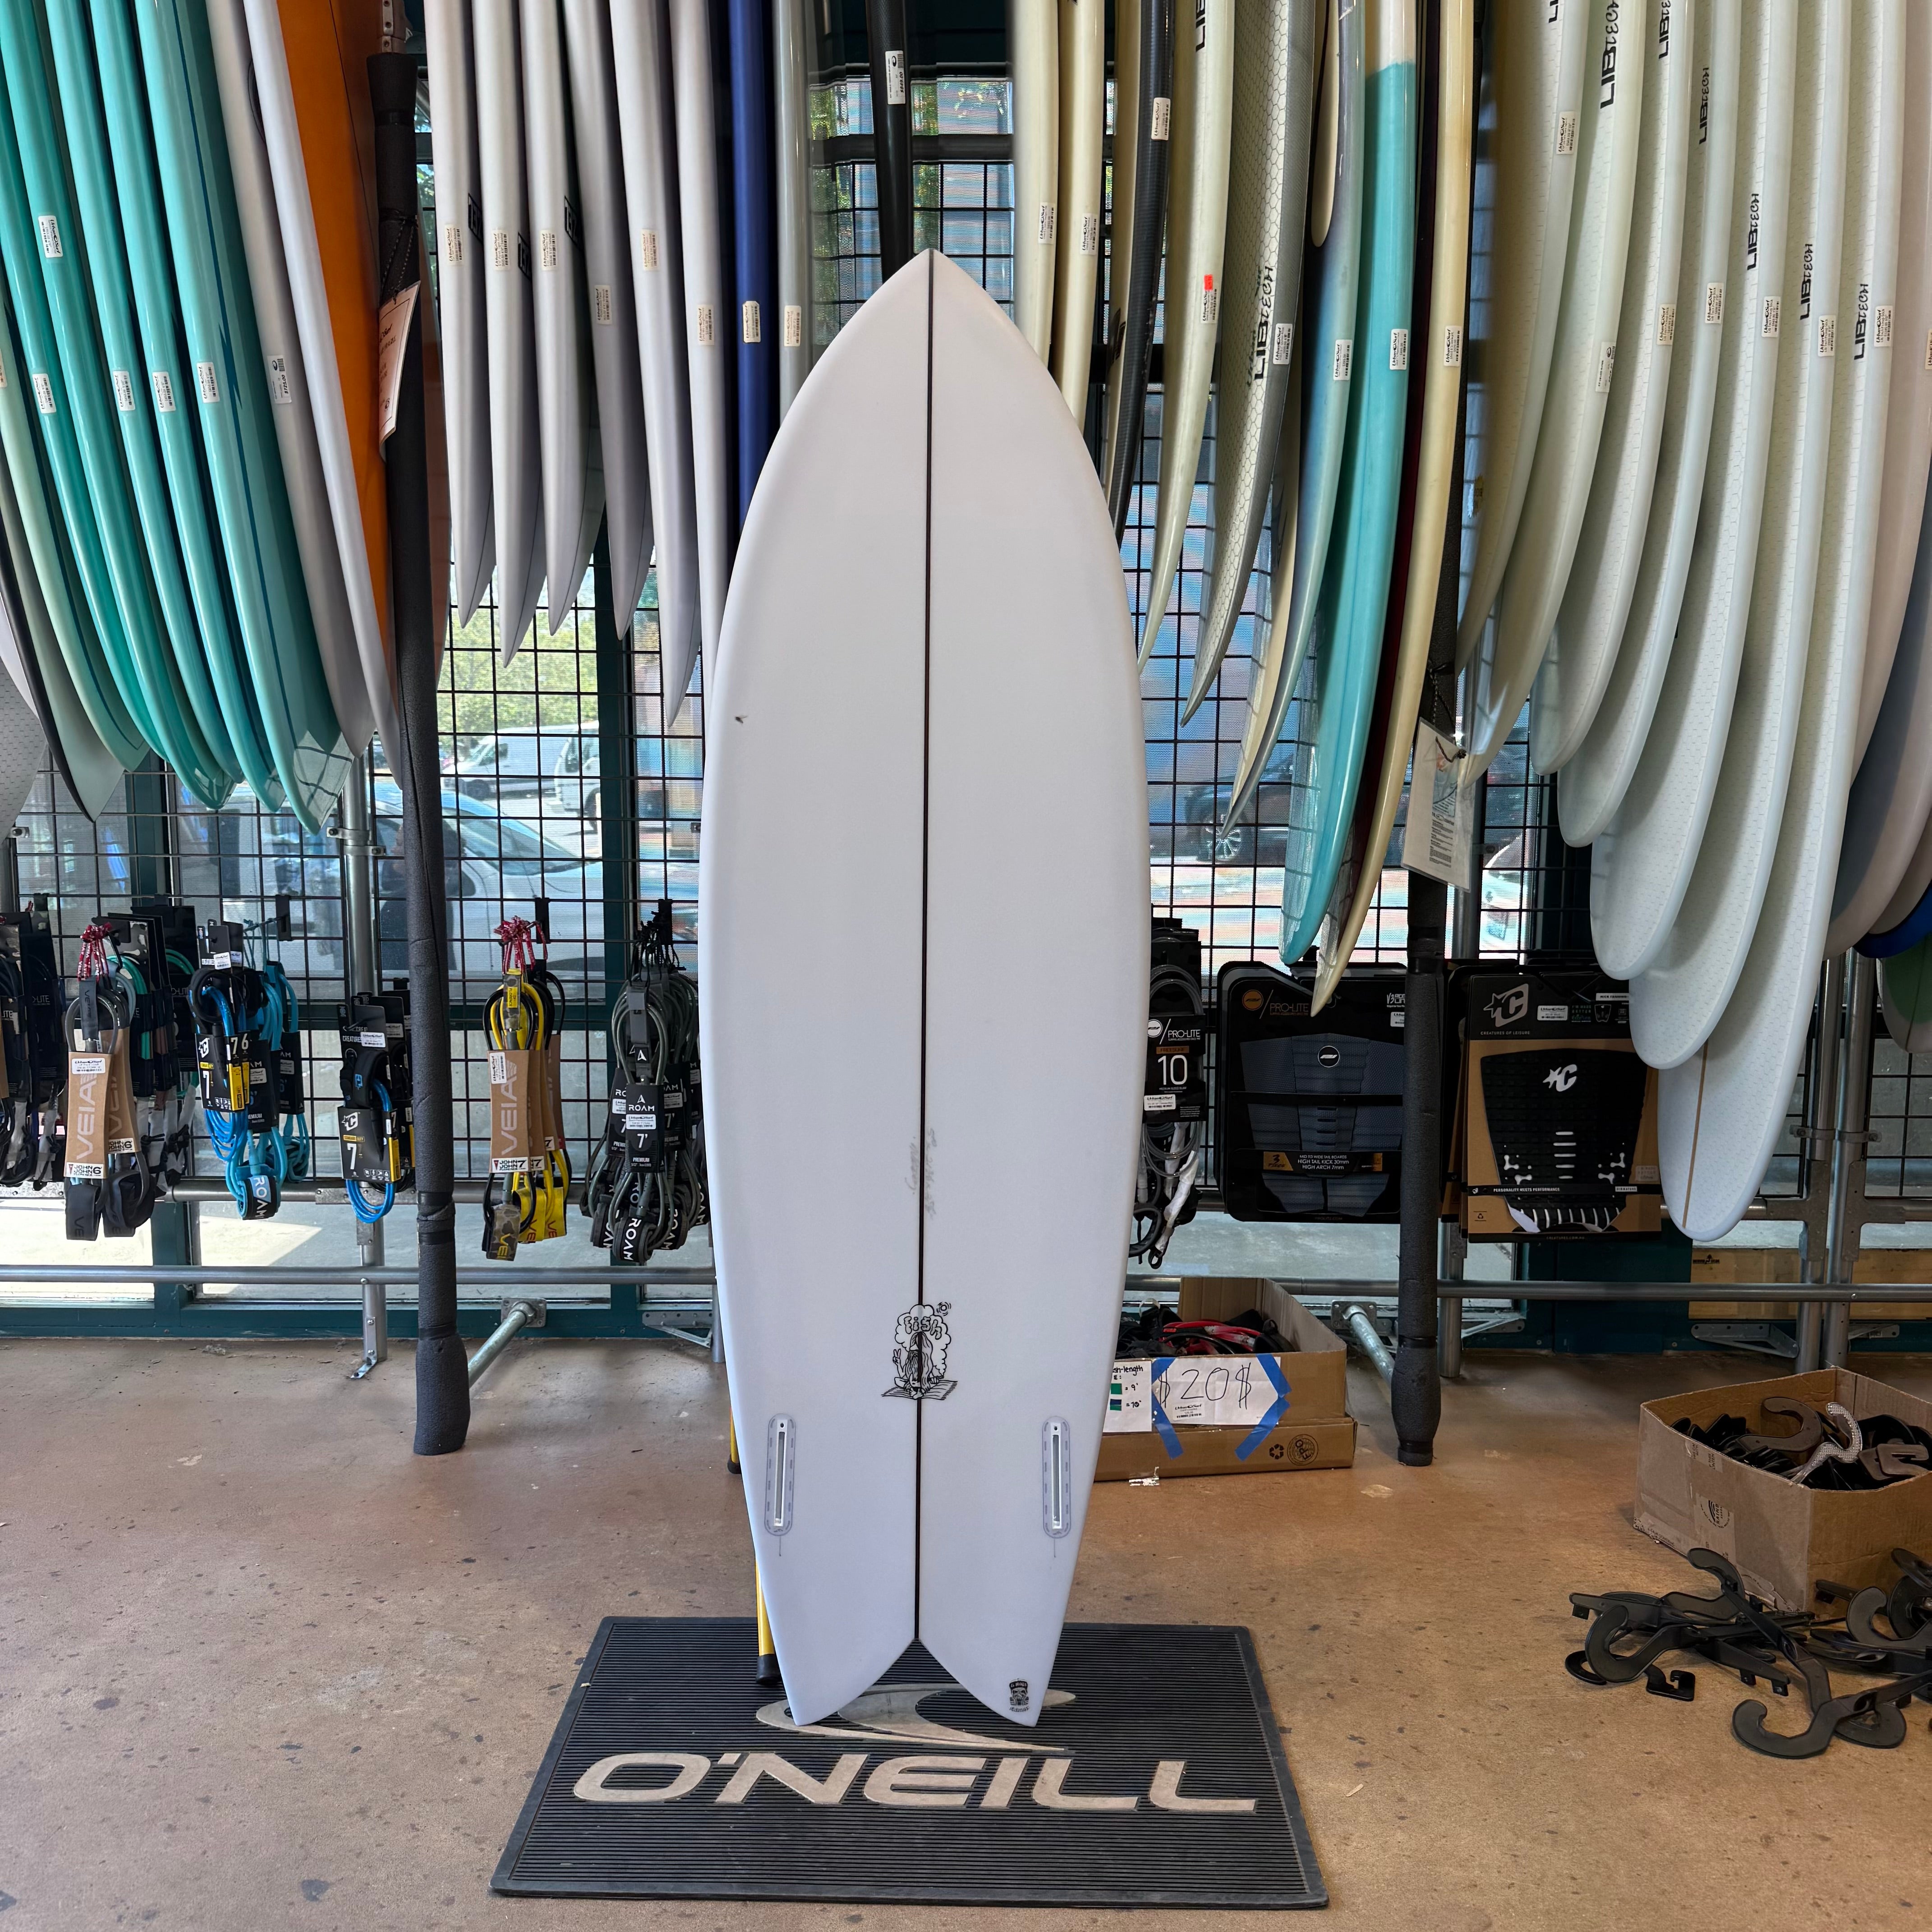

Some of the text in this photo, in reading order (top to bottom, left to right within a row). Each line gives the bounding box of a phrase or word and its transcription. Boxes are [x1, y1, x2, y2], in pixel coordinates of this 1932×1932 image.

[1270, 1003, 1309, 1012] PRO-LITE
[1158, 1054, 1187, 1085] 10
[203, 1070, 210, 1099] 7
[76, 1079, 97, 1160] VEIA
[501, 1076, 517, 1155] VEIA
[637, 1133, 648, 1148] 7'
[347, 1143, 356, 1169] 7
[1273, 1155, 1280, 1164] 3
[624, 1218, 642, 1261] ROAM
[904, 1316, 942, 1340] Fish
[573, 1752, 1257, 1811] O'NEILL
